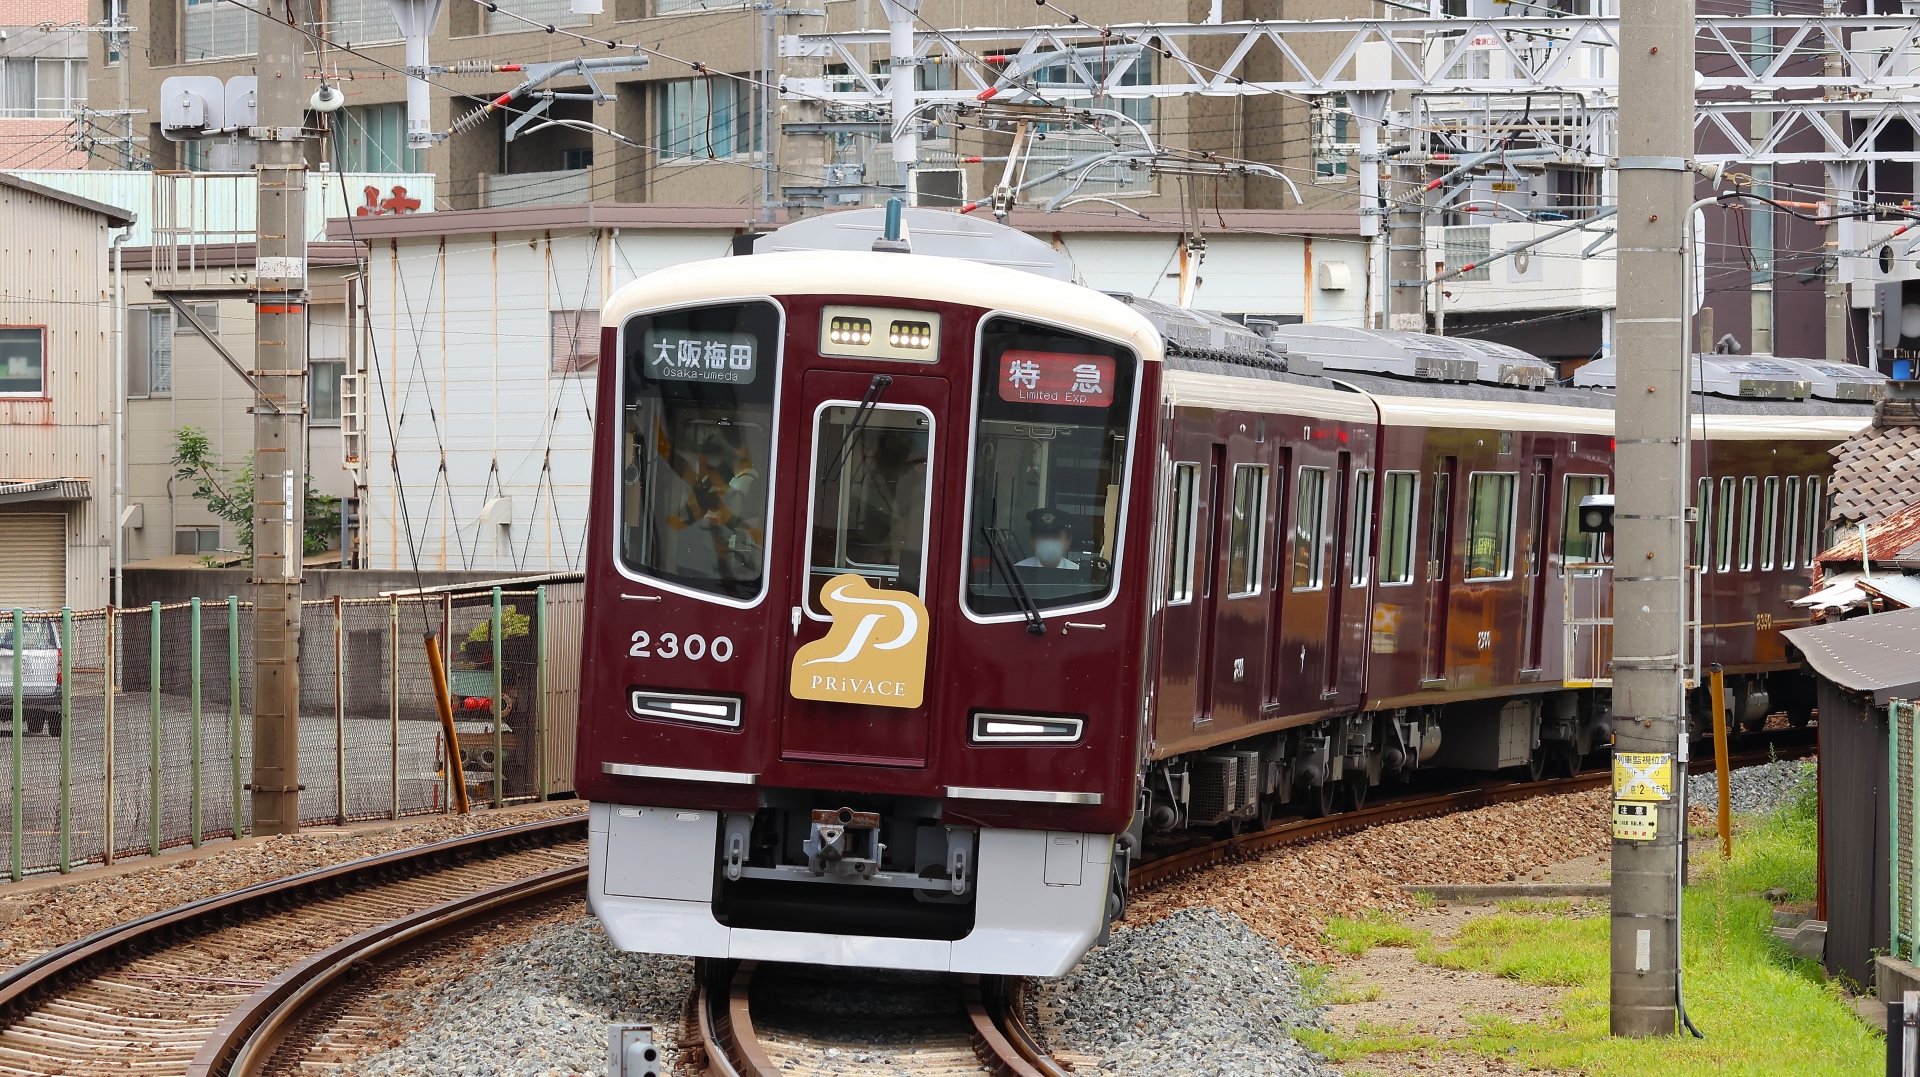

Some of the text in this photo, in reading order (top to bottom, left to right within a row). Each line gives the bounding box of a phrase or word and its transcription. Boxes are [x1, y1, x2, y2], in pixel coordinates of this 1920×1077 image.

[652, 338, 752, 370] 大阪梅田
[663, 366, 739, 382] Osaka-umeda
[1008, 360, 1102, 393] 特急
[1019, 389, 1089, 404] Limited Exp.
[629, 630, 733, 662] 2300
[811, 675, 906, 697] PRiVACE
[1620, 805, 1643, 815] 注意
